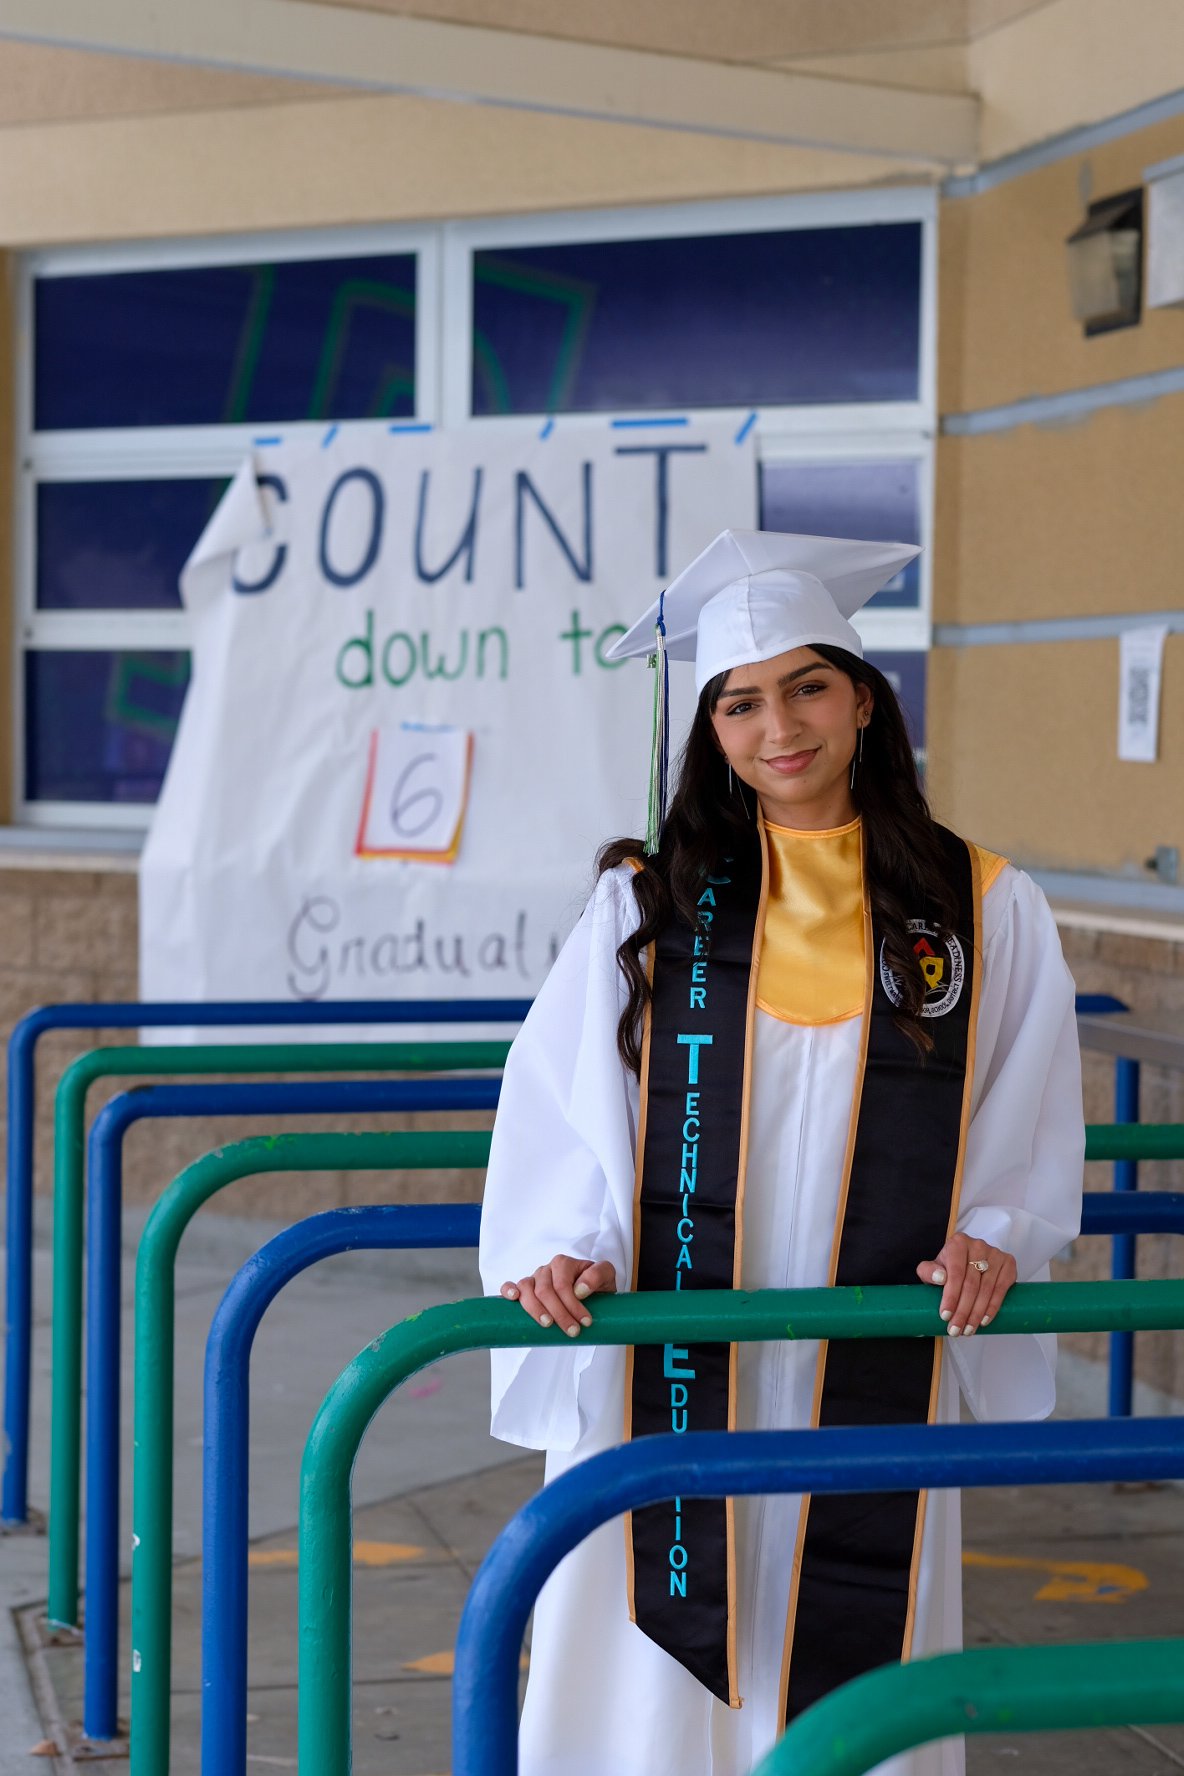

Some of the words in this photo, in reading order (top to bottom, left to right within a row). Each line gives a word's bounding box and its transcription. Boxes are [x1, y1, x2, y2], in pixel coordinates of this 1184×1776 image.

[335, 608, 509, 690] down
[390, 752, 444, 839] 6
[946, 936, 964, 983] EADINESS
[663, 1343, 696, 1598] EDUION
